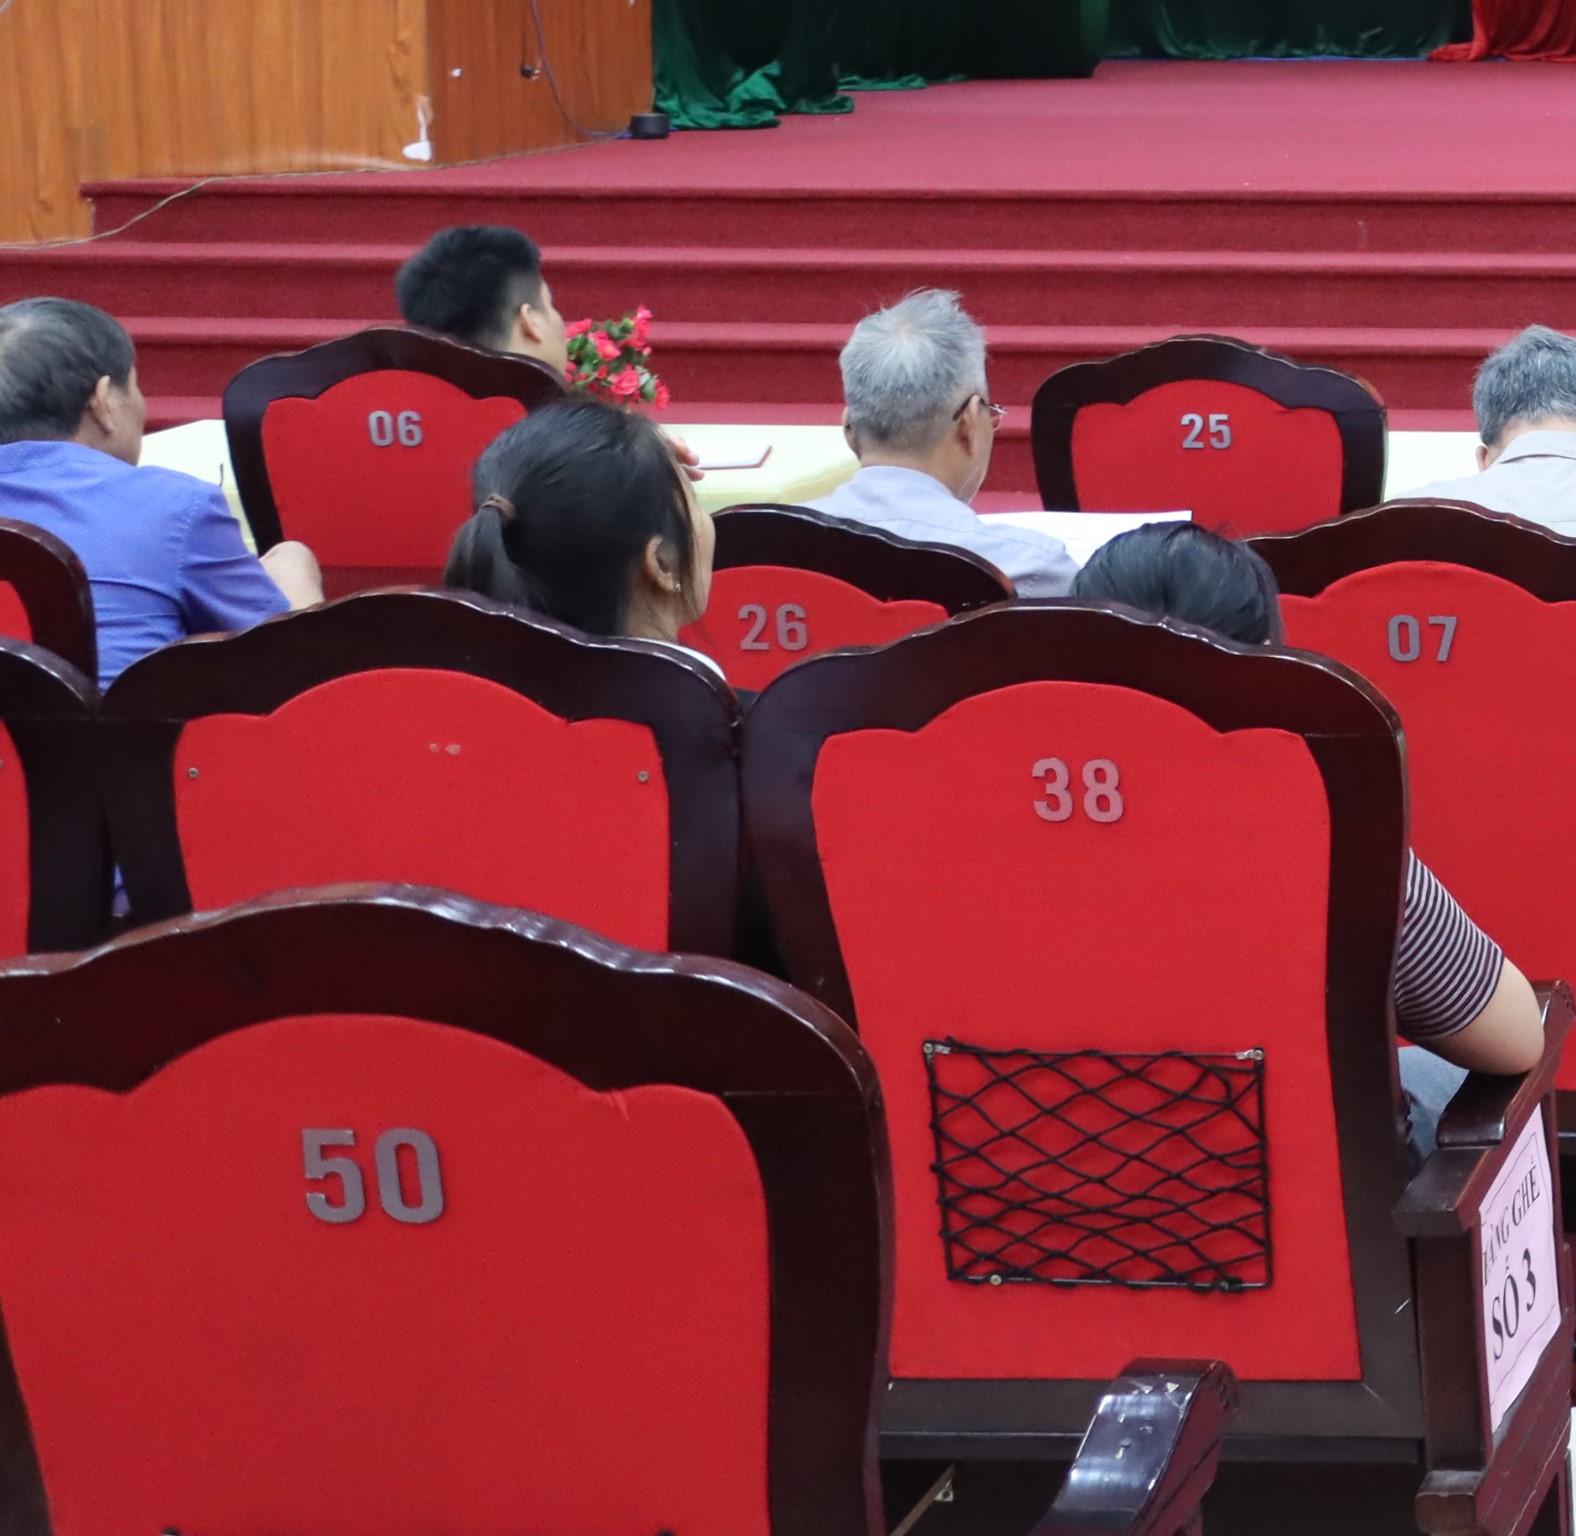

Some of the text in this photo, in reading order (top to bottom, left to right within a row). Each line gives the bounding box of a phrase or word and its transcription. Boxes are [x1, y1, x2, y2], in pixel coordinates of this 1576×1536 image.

[368, 410, 423, 447] 06
[1180, 413, 1232, 449] 25
[738, 604, 808, 651] 26
[1387, 615, 1458, 662] 07
[1033, 759, 1122, 822] 38
[301, 1127, 446, 1224] 50
[1511, 1154, 1540, 1228] GHẾ
[1491, 1247, 1537, 1362] SỐ 3
